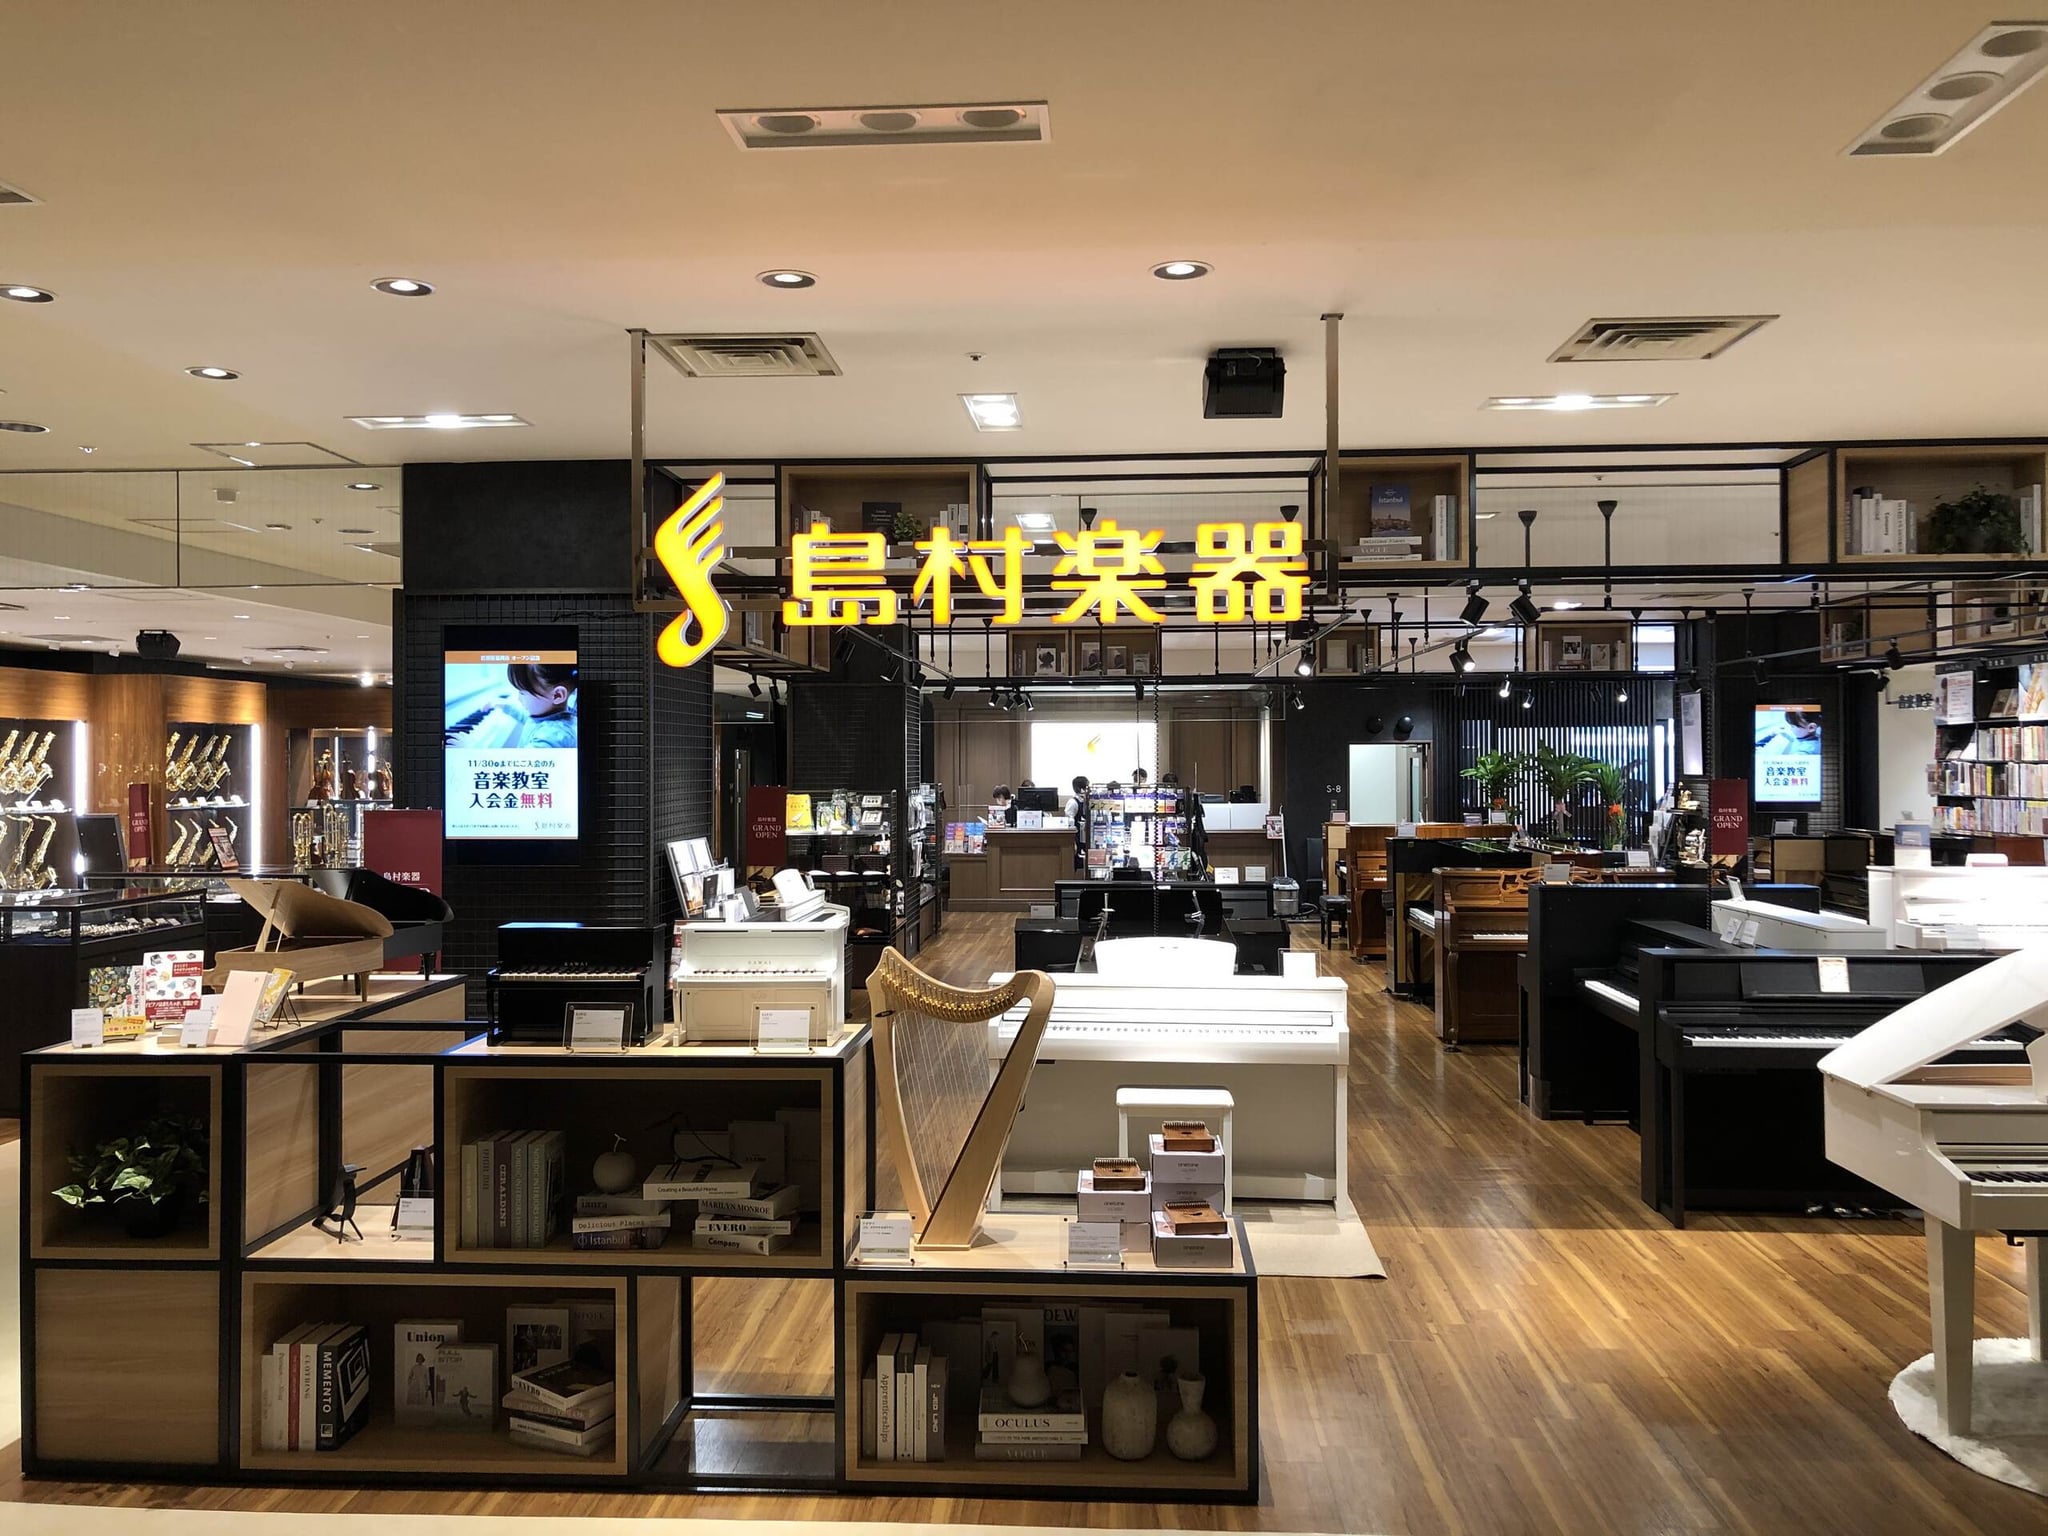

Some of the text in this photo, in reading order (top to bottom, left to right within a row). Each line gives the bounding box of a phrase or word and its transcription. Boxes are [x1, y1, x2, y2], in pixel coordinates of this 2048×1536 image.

[782, 519, 1311, 627] 島村楽器
[1766, 766, 1807, 777] 音楽教室
[473, 771, 550, 790] 音楽教室
[1326, 784, 1342, 794] S-8
[468, 792, 553, 809] 入会金無料
[752, 824, 782, 832] GRAND
[755, 831, 778, 839] OPEN
[701, 1200, 769, 1214] MARILYN MONROE
[578, 1221, 616, 1230] Delicious
[708, 1223, 747, 1232] EVERO
[590, 1234, 626, 1246] Istanbul
[708, 1237, 740, 1248] Company
[406, 1331, 446, 1343] Union
[322, 1351, 332, 1413] MEMENTO
[879, 1374, 890, 1443] Apprenticeships
[994, 1418, 1051, 1428] OCULUS
